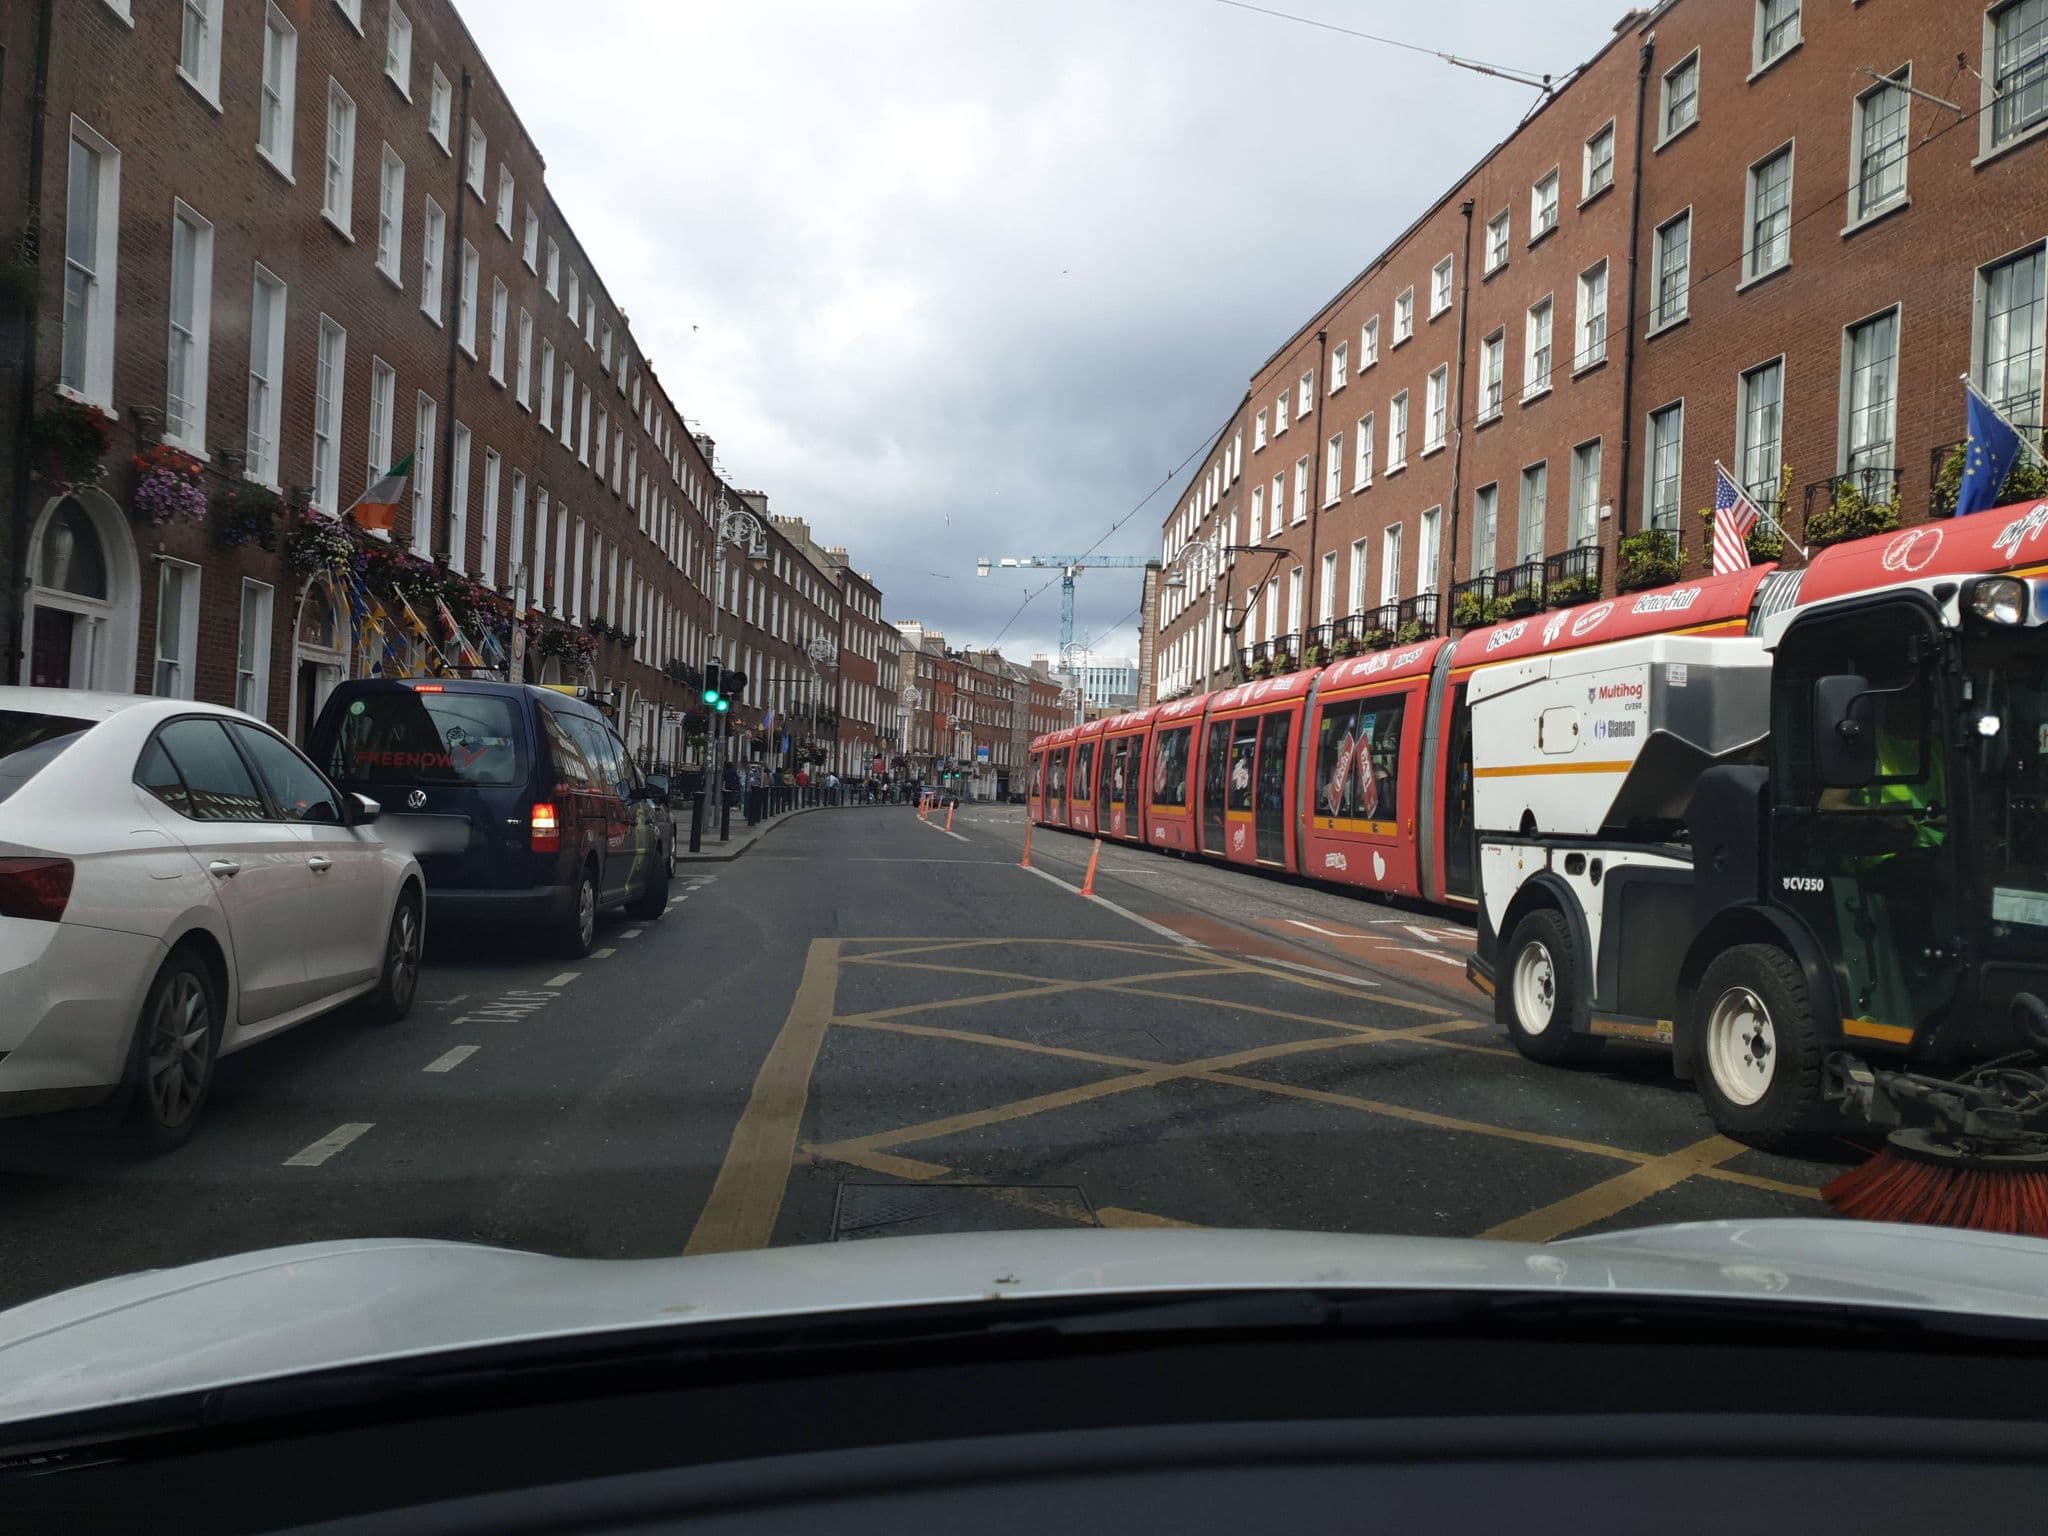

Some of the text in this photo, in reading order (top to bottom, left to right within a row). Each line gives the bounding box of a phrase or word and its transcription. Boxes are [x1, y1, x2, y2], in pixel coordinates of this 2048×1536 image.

[1599, 684, 1643, 699] Multihog
[356, 751, 454, 768] FREENOW
[1791, 877, 1824, 892] CV350
